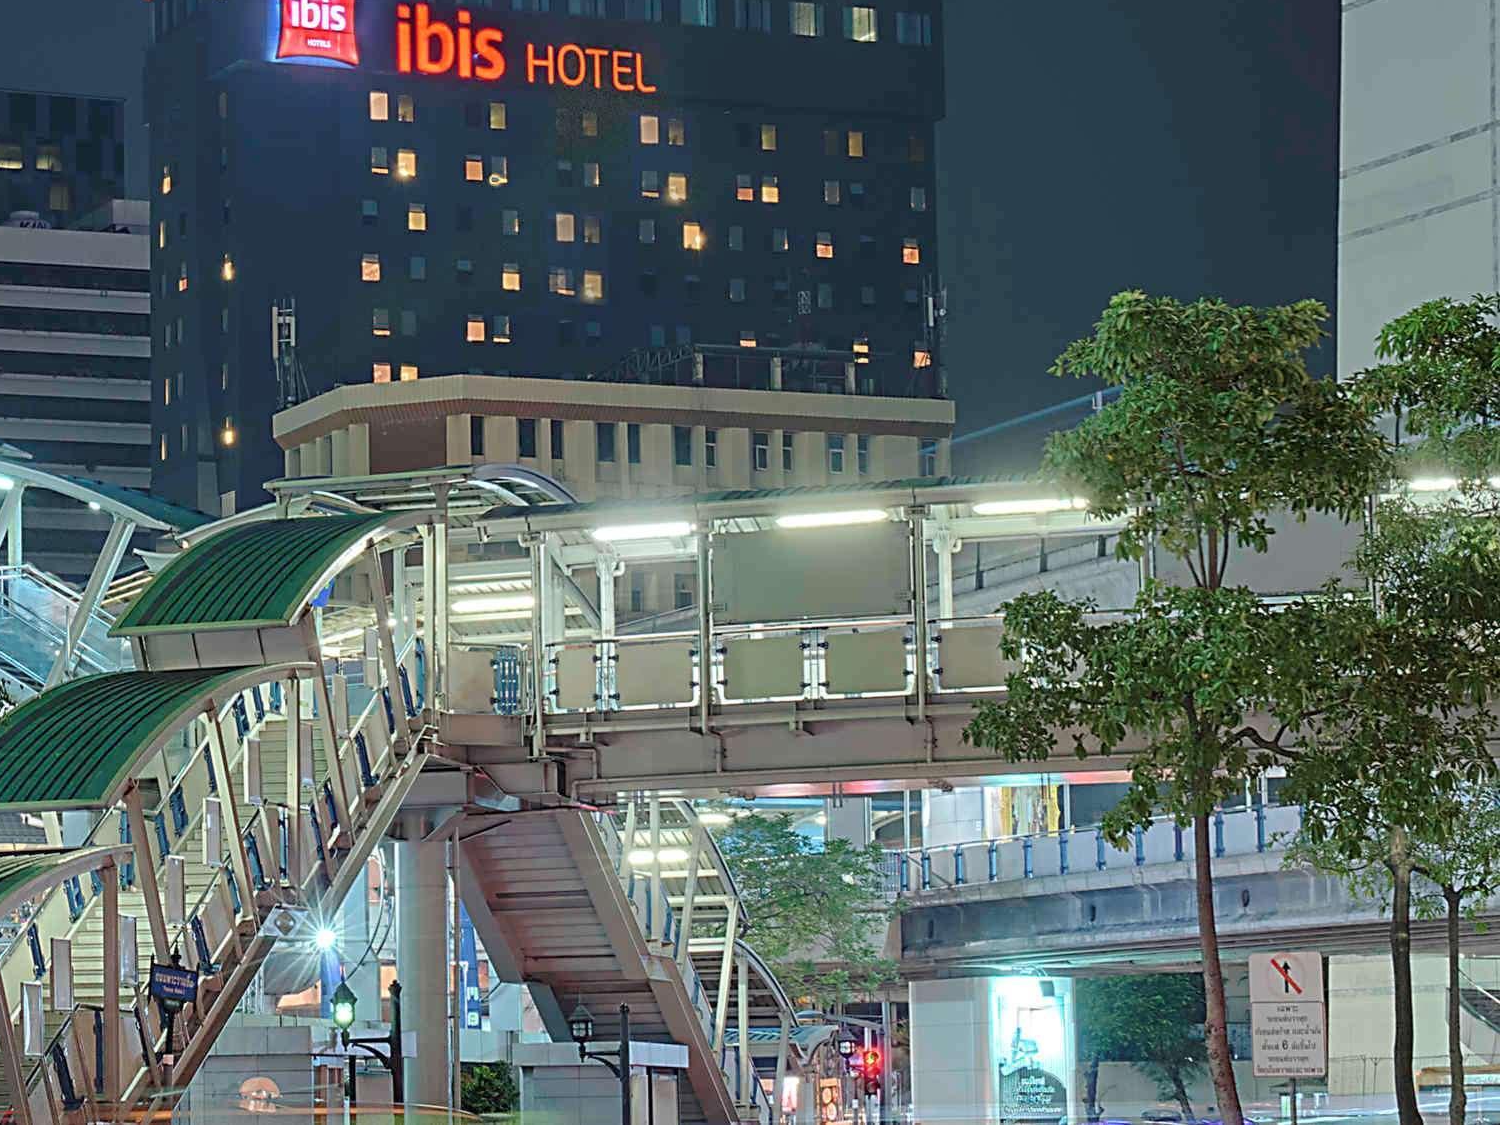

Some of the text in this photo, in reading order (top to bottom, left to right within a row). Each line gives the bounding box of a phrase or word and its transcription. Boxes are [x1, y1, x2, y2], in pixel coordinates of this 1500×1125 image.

[395, 3, 657, 93] ibis HOTEL
[1282, 1039, 1289, 1050] 6
